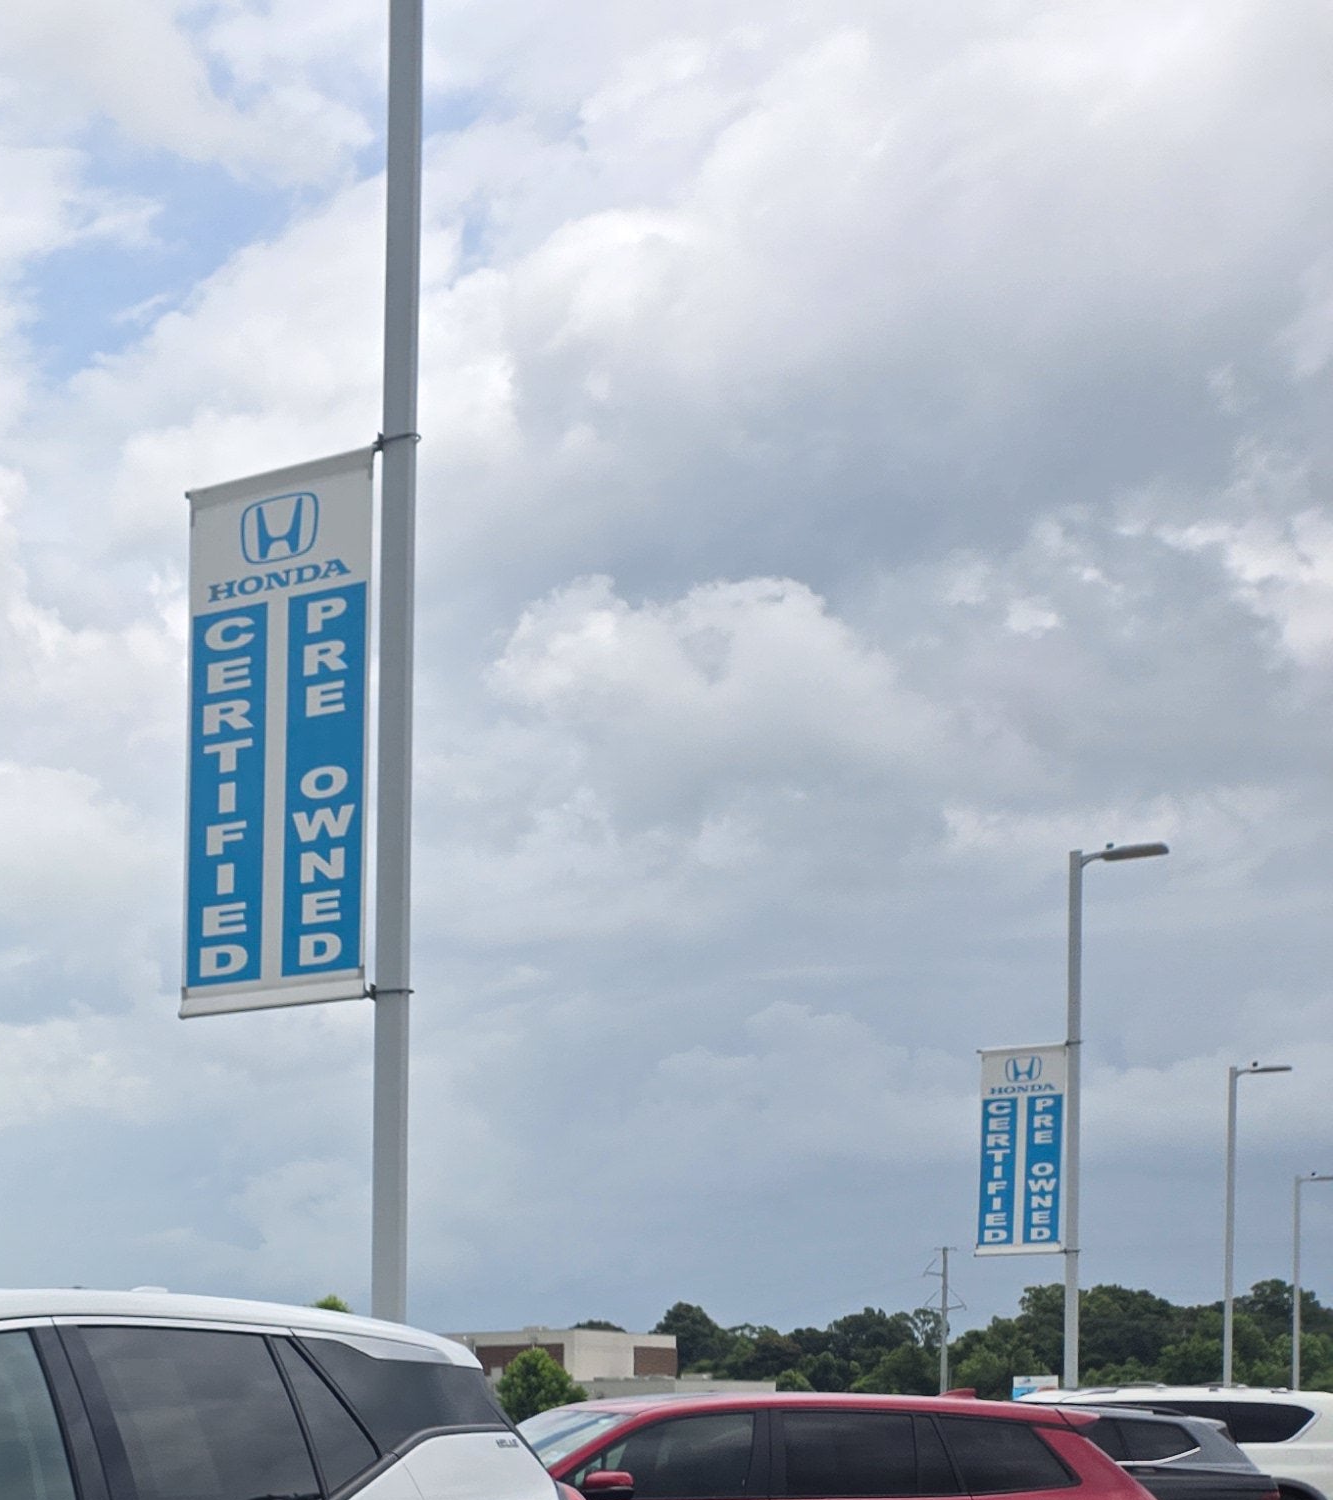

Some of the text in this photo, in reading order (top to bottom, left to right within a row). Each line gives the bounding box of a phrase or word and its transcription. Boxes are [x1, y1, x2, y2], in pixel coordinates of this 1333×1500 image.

[207, 558, 351, 603] HONDA
[199, 615, 255, 979] CERTIFIED
[292, 596, 355, 967] PRE OWNED
[989, 1083, 1056, 1095] HONDA
[983, 1101, 1012, 1243] CERTIFIED
[1028, 1097, 1056, 1241] PRE OWNED
